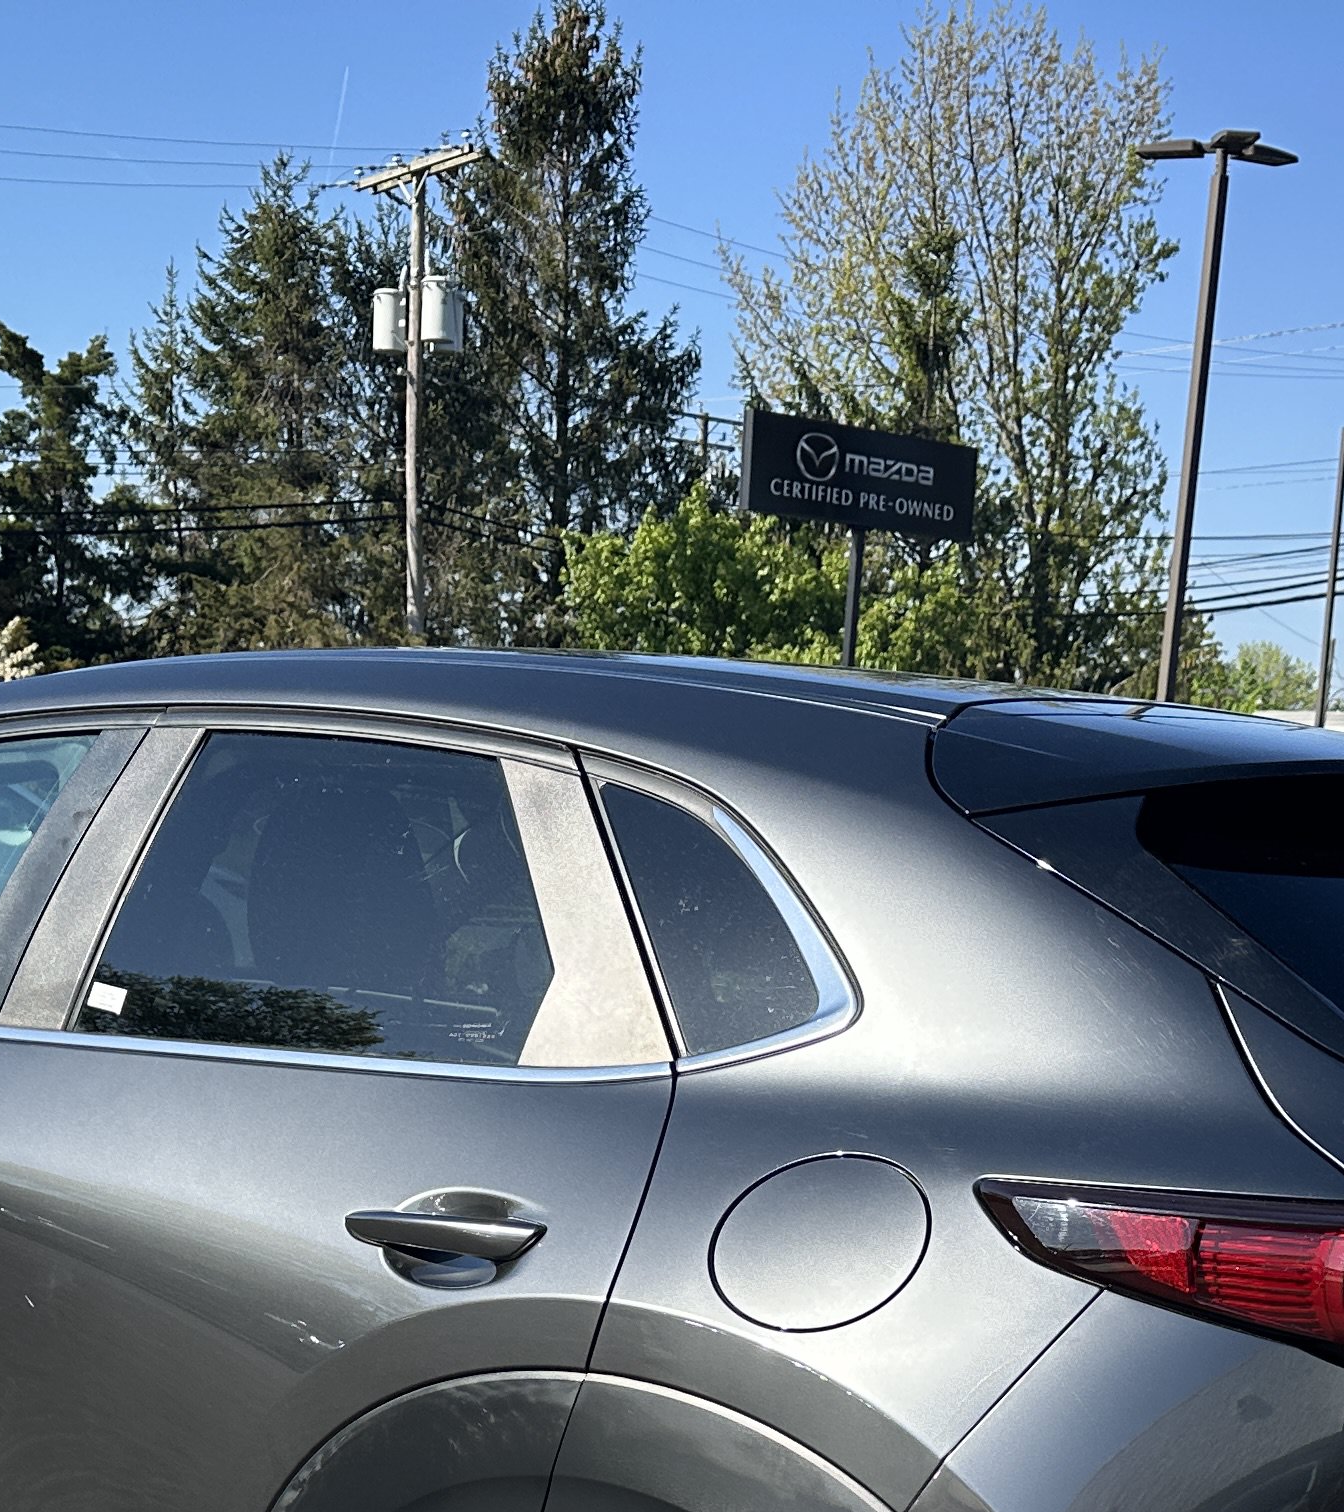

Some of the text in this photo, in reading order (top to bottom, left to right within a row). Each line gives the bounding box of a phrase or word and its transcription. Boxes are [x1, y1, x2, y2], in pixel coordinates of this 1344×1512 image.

[845, 453, 935, 486] mazda
[770, 478, 955, 522] CERTIFIED PRE-OWNED
